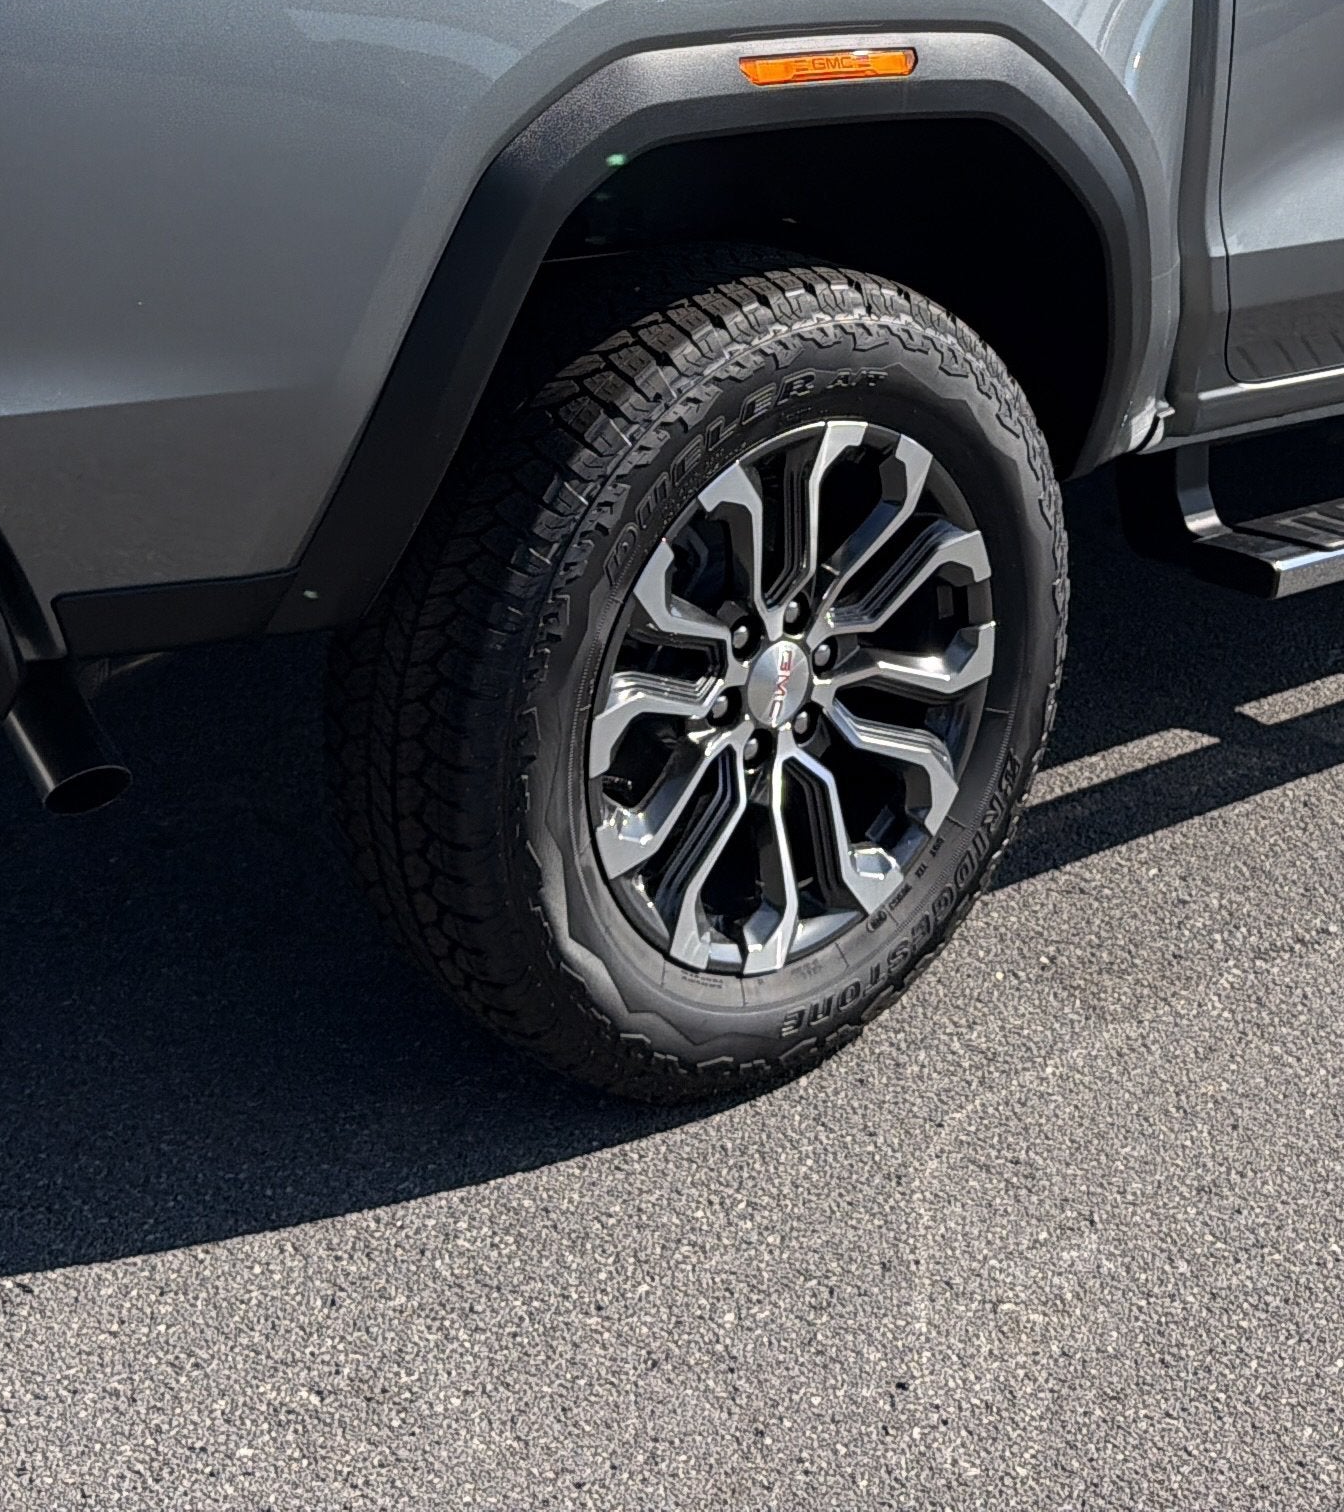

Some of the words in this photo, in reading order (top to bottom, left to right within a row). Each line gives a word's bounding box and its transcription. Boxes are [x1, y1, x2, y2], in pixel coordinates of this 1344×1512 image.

[811, 56, 853, 70] GMC
[604, 368, 816, 587] DUELER
[780, 747, 1023, 1038] BRIDGESTONE
